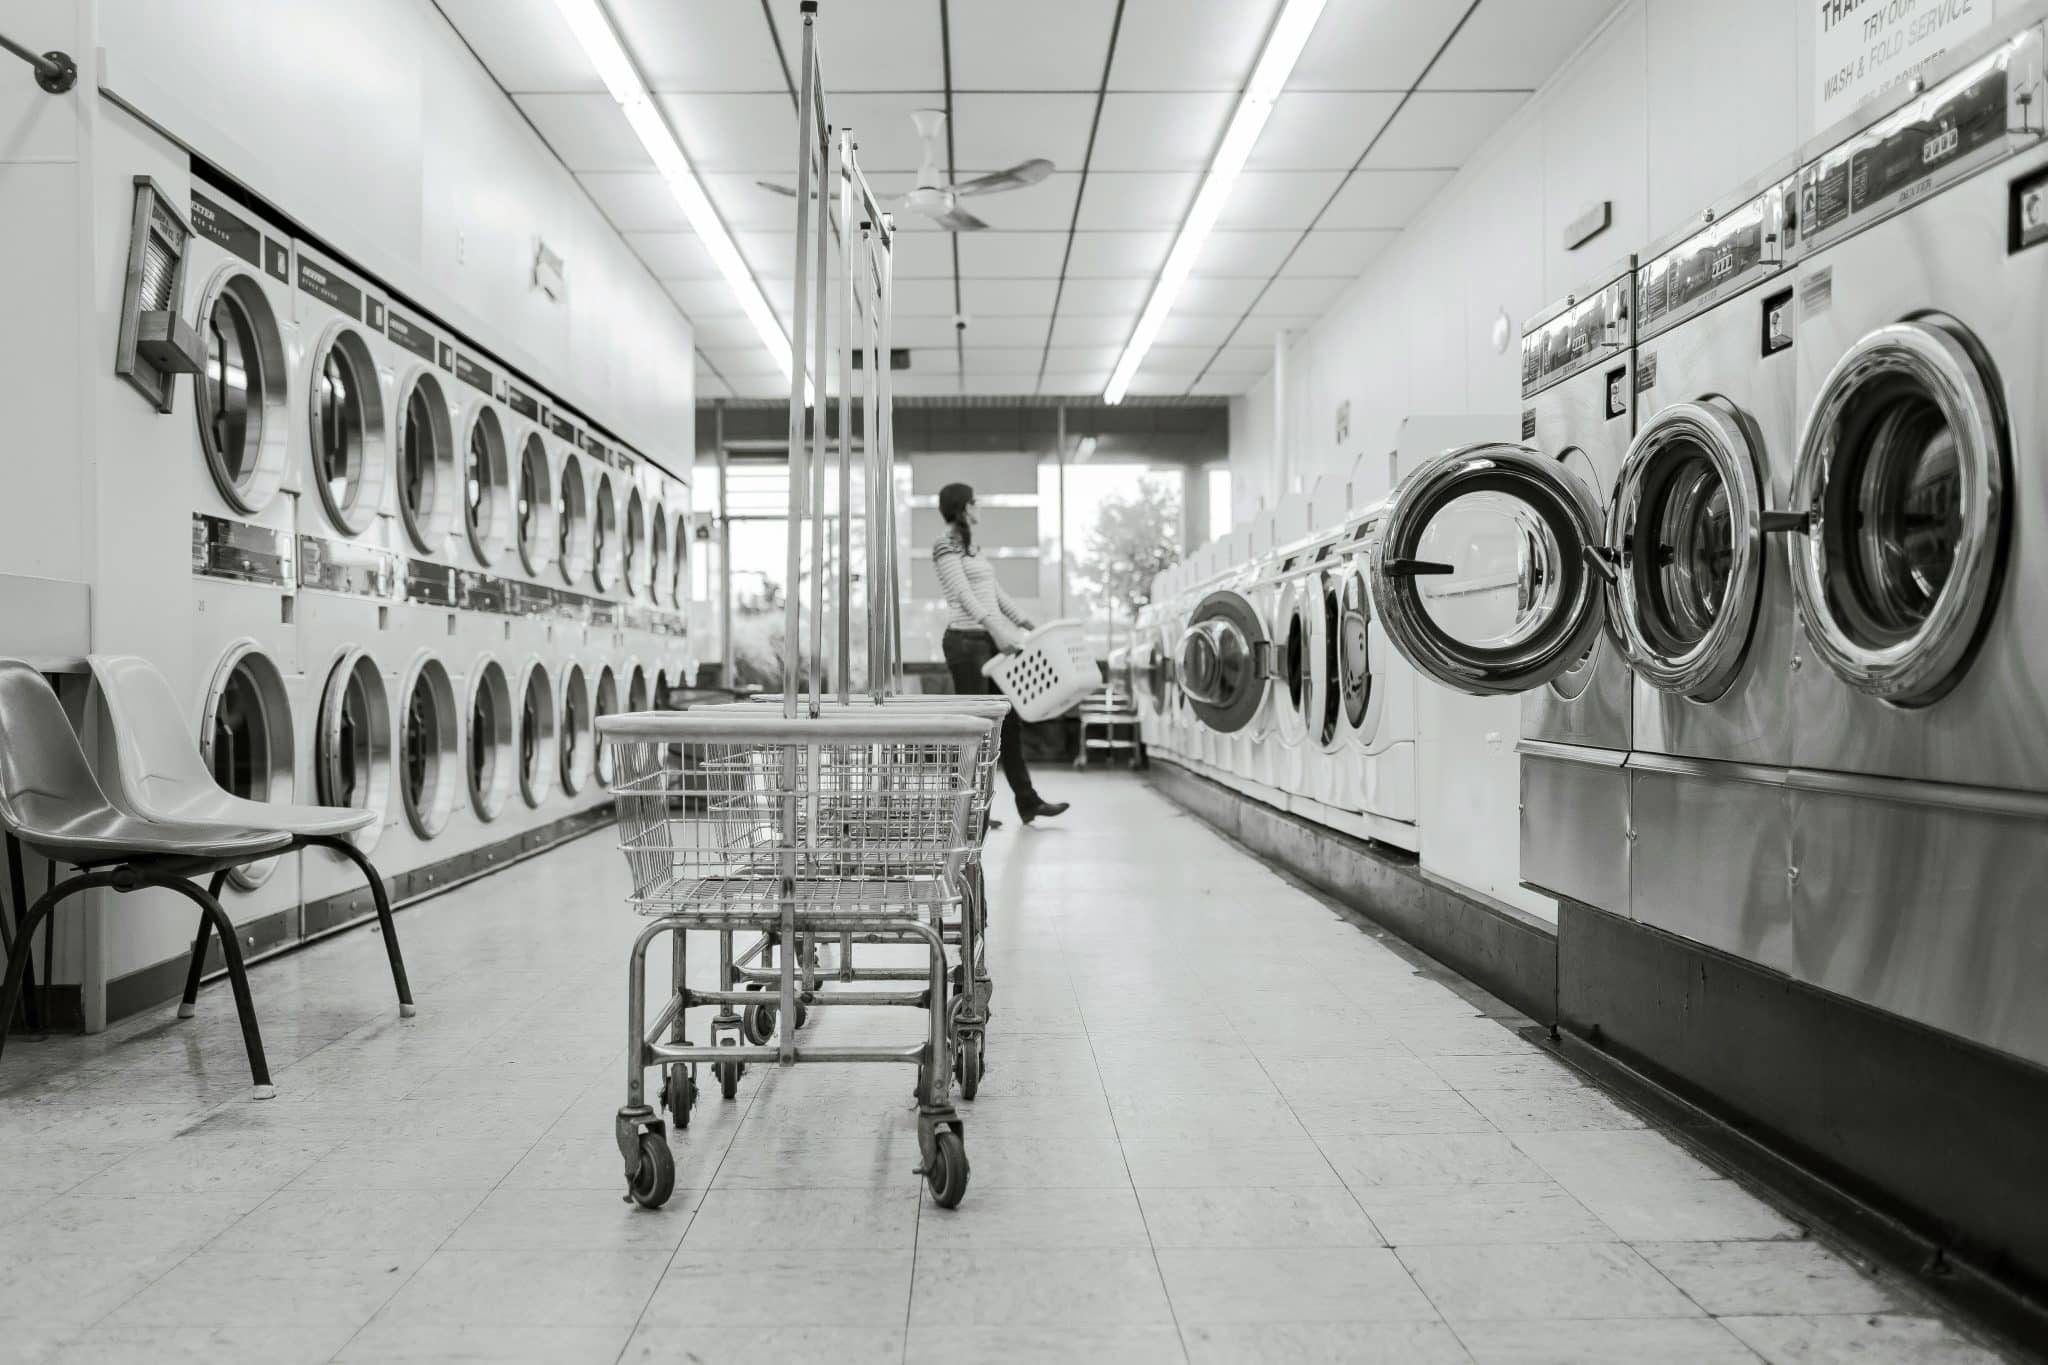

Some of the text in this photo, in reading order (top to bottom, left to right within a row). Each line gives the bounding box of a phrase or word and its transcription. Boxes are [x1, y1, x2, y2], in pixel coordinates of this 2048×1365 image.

[1822, 0, 1865, 32] THA
[1864, 0, 1916, 43] TRY OUR
[1824, 61, 1854, 102] WASH
[1857, 55, 1865, 80] &
[1869, 29, 1903, 73] FOLD
[1907, 0, 1973, 47] SERVICE
